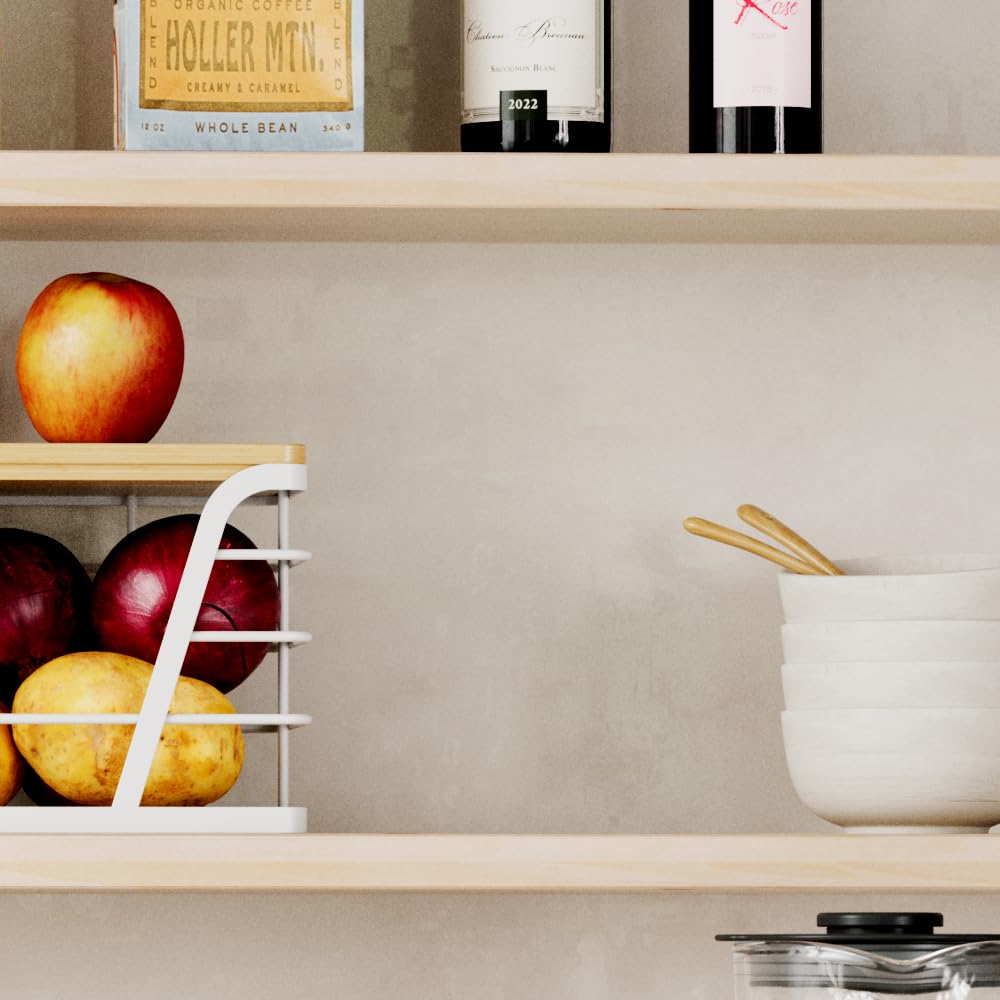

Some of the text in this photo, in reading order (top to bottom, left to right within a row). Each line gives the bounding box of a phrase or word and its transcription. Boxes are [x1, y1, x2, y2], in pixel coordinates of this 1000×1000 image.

[174, 0, 313, 11] ORGANIC COFFEE
[166, 19, 255, 73] HOLLER
[187, 81, 231, 93] CREAMY
[249, 82, 301, 94] CARAMEL
[508, 98, 539, 110] 2022
[195, 122, 298, 134] WHOLE BEAN
